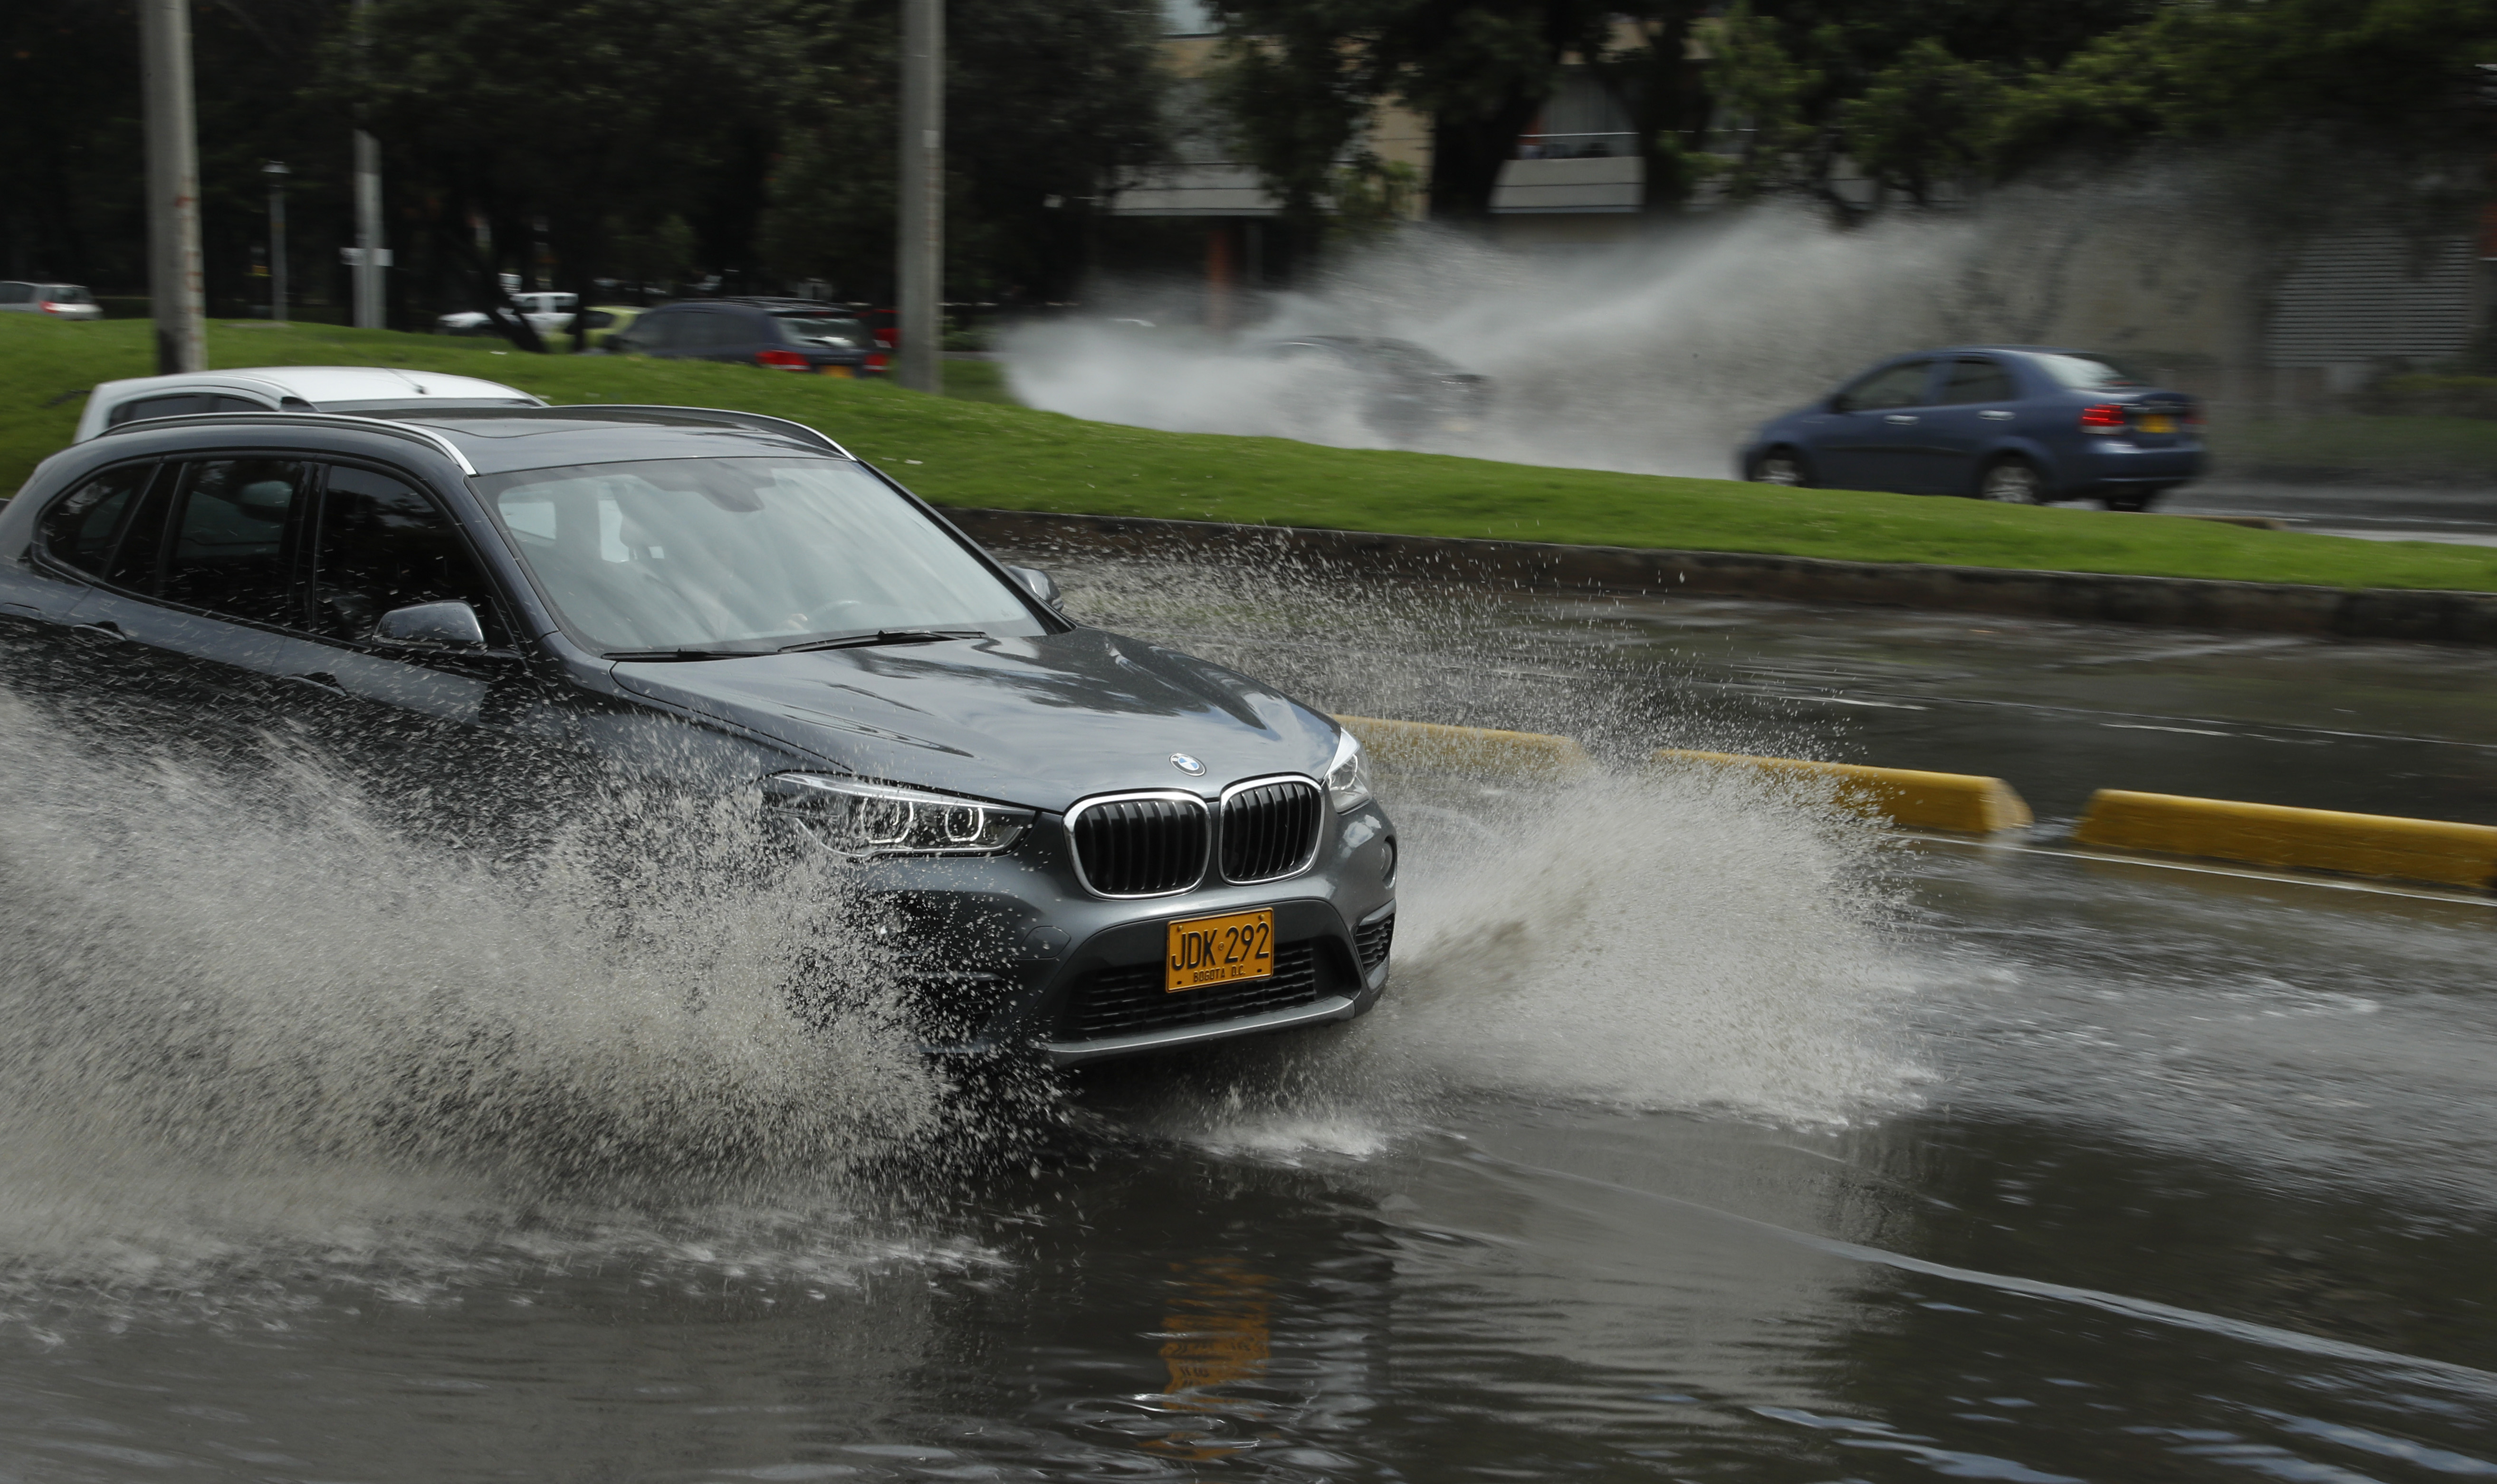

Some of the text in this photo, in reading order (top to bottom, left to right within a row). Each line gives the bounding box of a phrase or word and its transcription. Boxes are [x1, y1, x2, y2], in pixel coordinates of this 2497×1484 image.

[1172, 921, 1269, 970] JDK 292
[1194, 964, 1245, 982] BOGOTA D.C.
